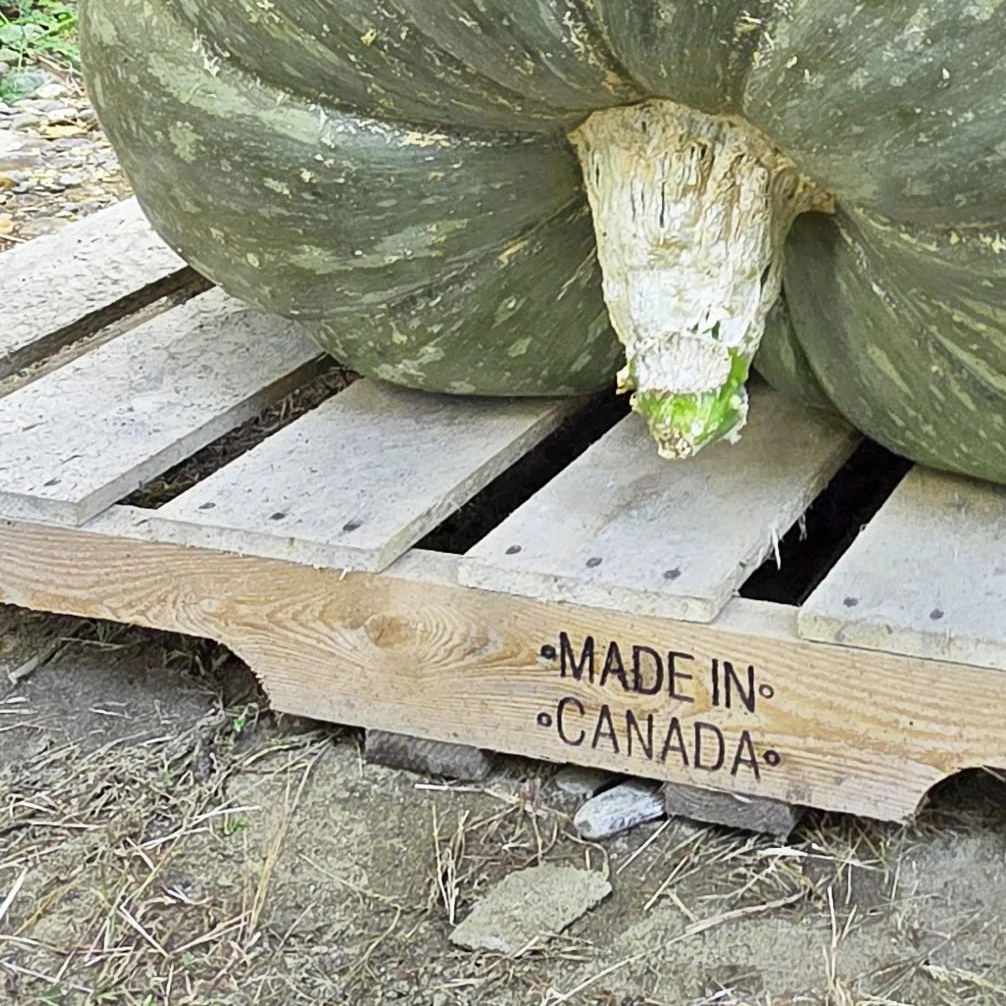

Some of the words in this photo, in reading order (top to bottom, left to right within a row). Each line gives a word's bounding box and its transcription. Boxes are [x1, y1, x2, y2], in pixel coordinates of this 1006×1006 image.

[559, 631, 695, 703] MADE
[711, 658, 756, 713] IN
[556, 697, 761, 782] CANADA
